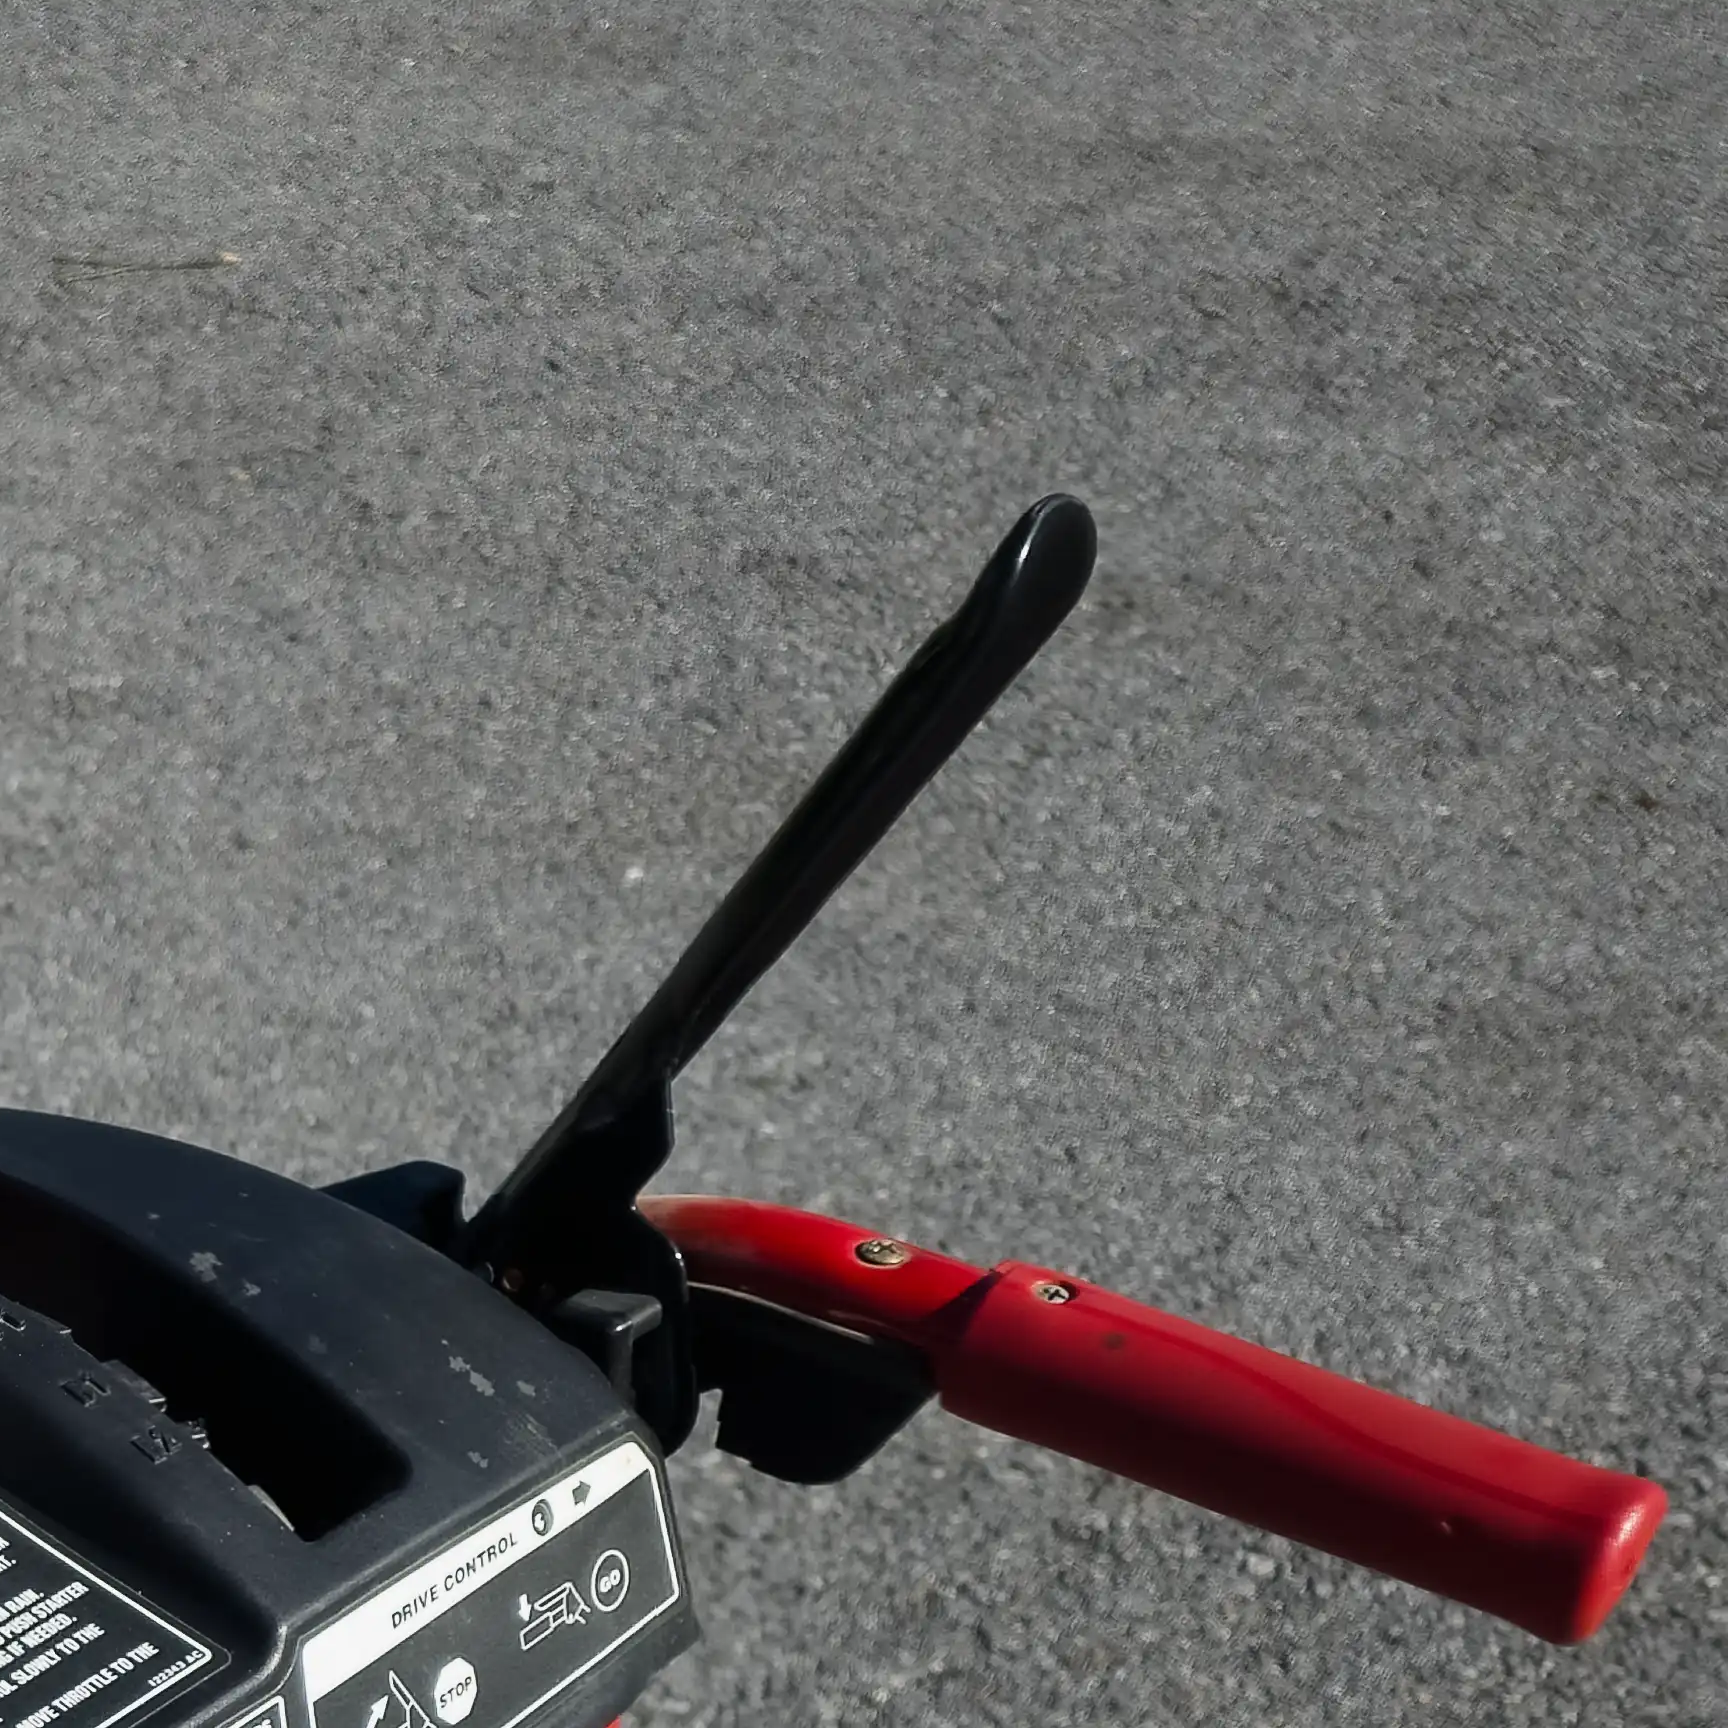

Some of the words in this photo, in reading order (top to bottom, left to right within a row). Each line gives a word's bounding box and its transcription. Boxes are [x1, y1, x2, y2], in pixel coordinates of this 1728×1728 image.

[391, 1584, 438, 1628] DRIVE
[444, 1532, 516, 1591] CONTROL
[599, 1569, 620, 1592] GO
[30, 1581, 89, 1618] STARTER
[5, 1640, 25, 1656] IF
[10, 1648, 61, 1684] SLOWLY
[54, 1637, 80, 1654] TO
[72, 1622, 104, 1644] THE
[51, 1667, 118, 1711] THROTTLE
[109, 1657, 134, 1673] TO
[125, 1641, 159, 1662] THE
[439, 1676, 471, 1708] STOP
